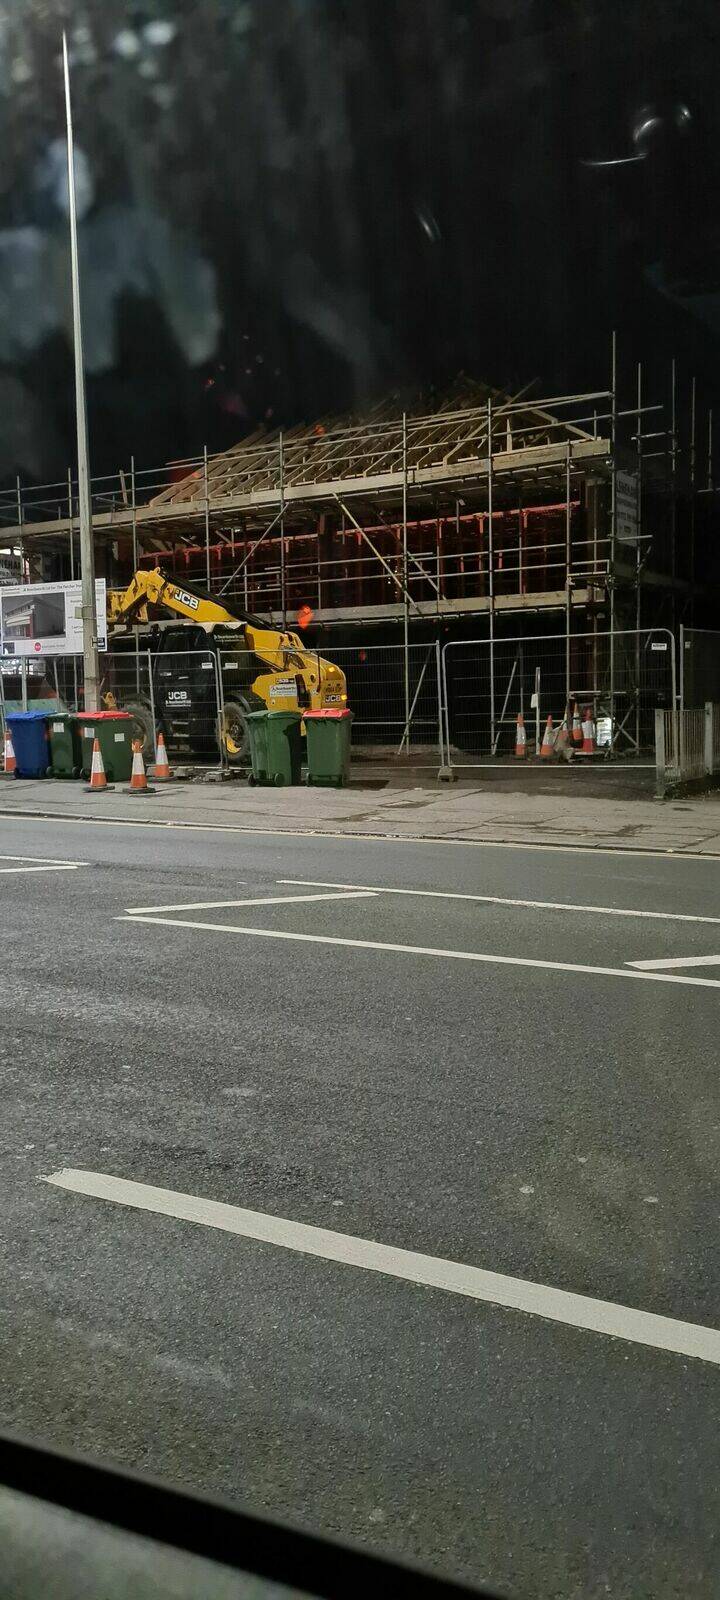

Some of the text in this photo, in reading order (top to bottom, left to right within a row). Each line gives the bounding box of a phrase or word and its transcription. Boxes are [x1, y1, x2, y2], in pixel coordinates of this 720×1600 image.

[174, 589, 199, 609] JCB
[168, 691, 188, 700] JCB
[325, 694, 341, 702] JCB
